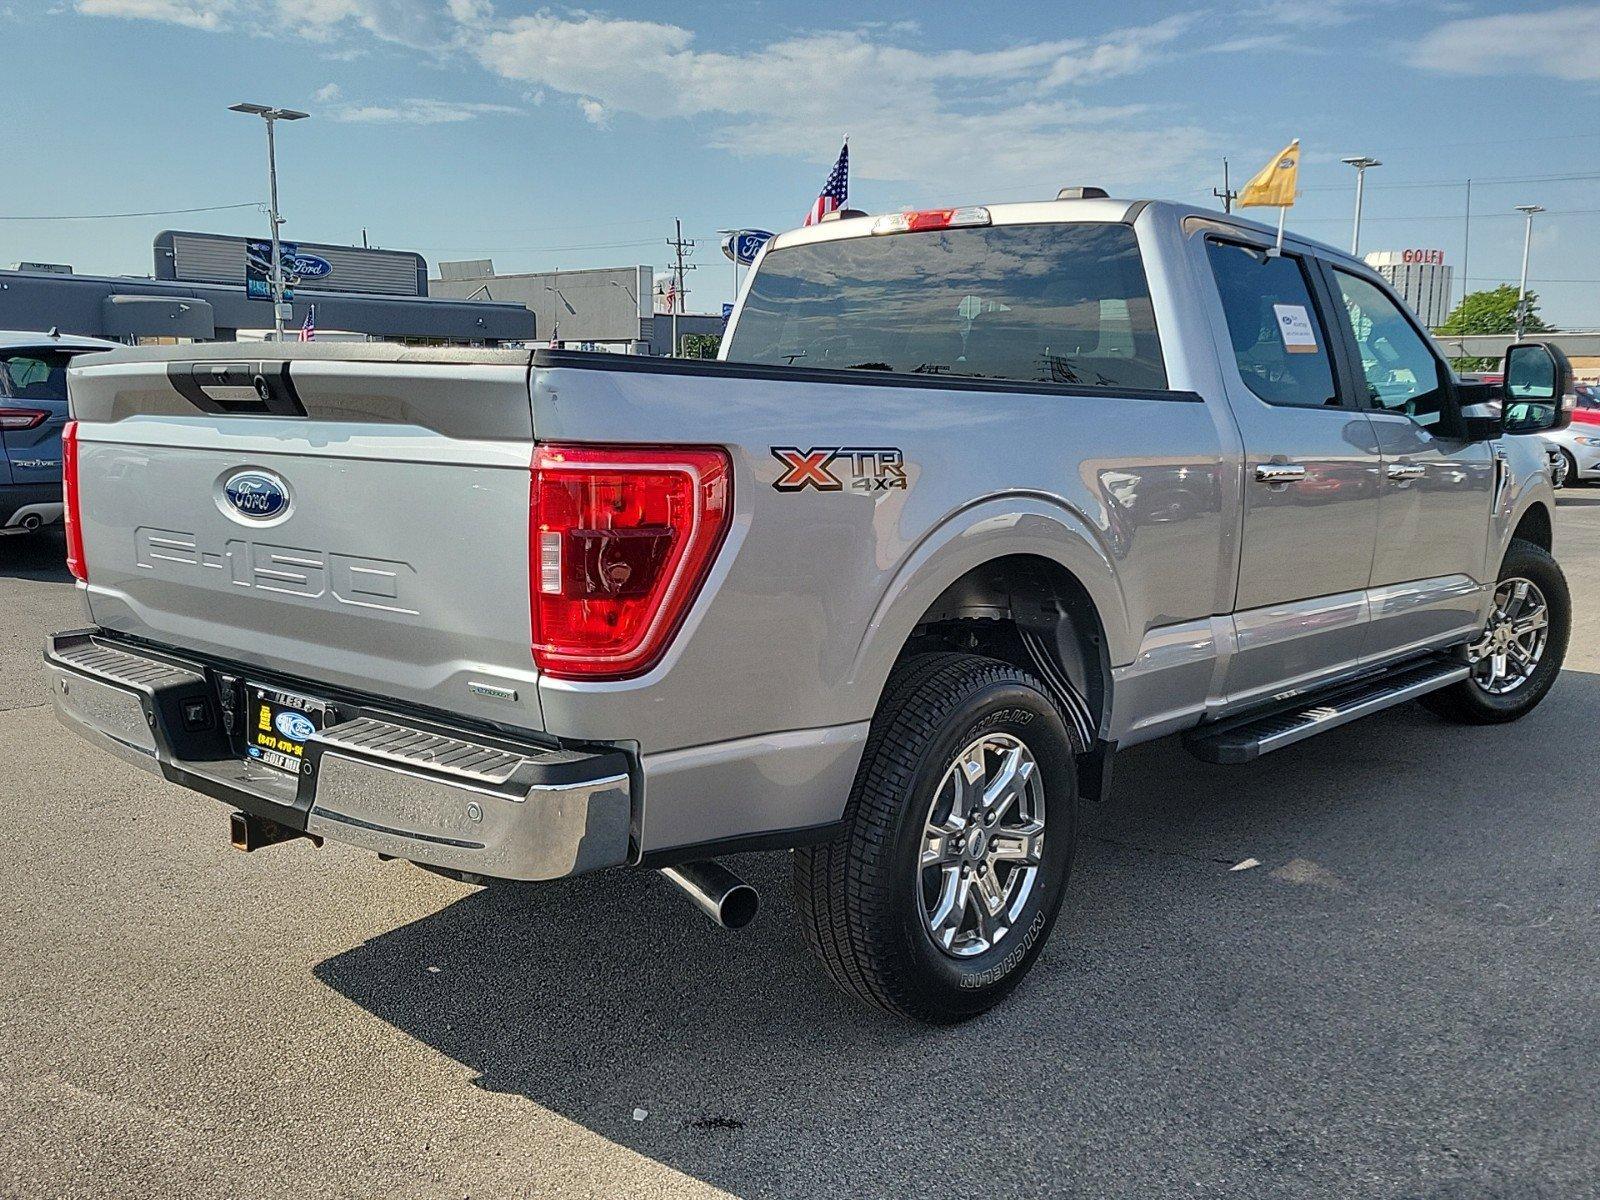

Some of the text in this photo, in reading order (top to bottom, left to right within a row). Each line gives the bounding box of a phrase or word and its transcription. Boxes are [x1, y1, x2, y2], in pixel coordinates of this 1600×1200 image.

[1402, 248, 1438, 263] GOLF
[293, 258, 322, 275] Ford
[769, 445, 908, 493] XTR
[234, 481, 271, 511] Ford
[134, 525, 421, 616] F-150
[266, 691, 303, 708] ILES
[258, 733, 276, 748] (847)
[263, 751, 285, 767] GOLF
[960, 910, 1046, 989] MICHELIN
